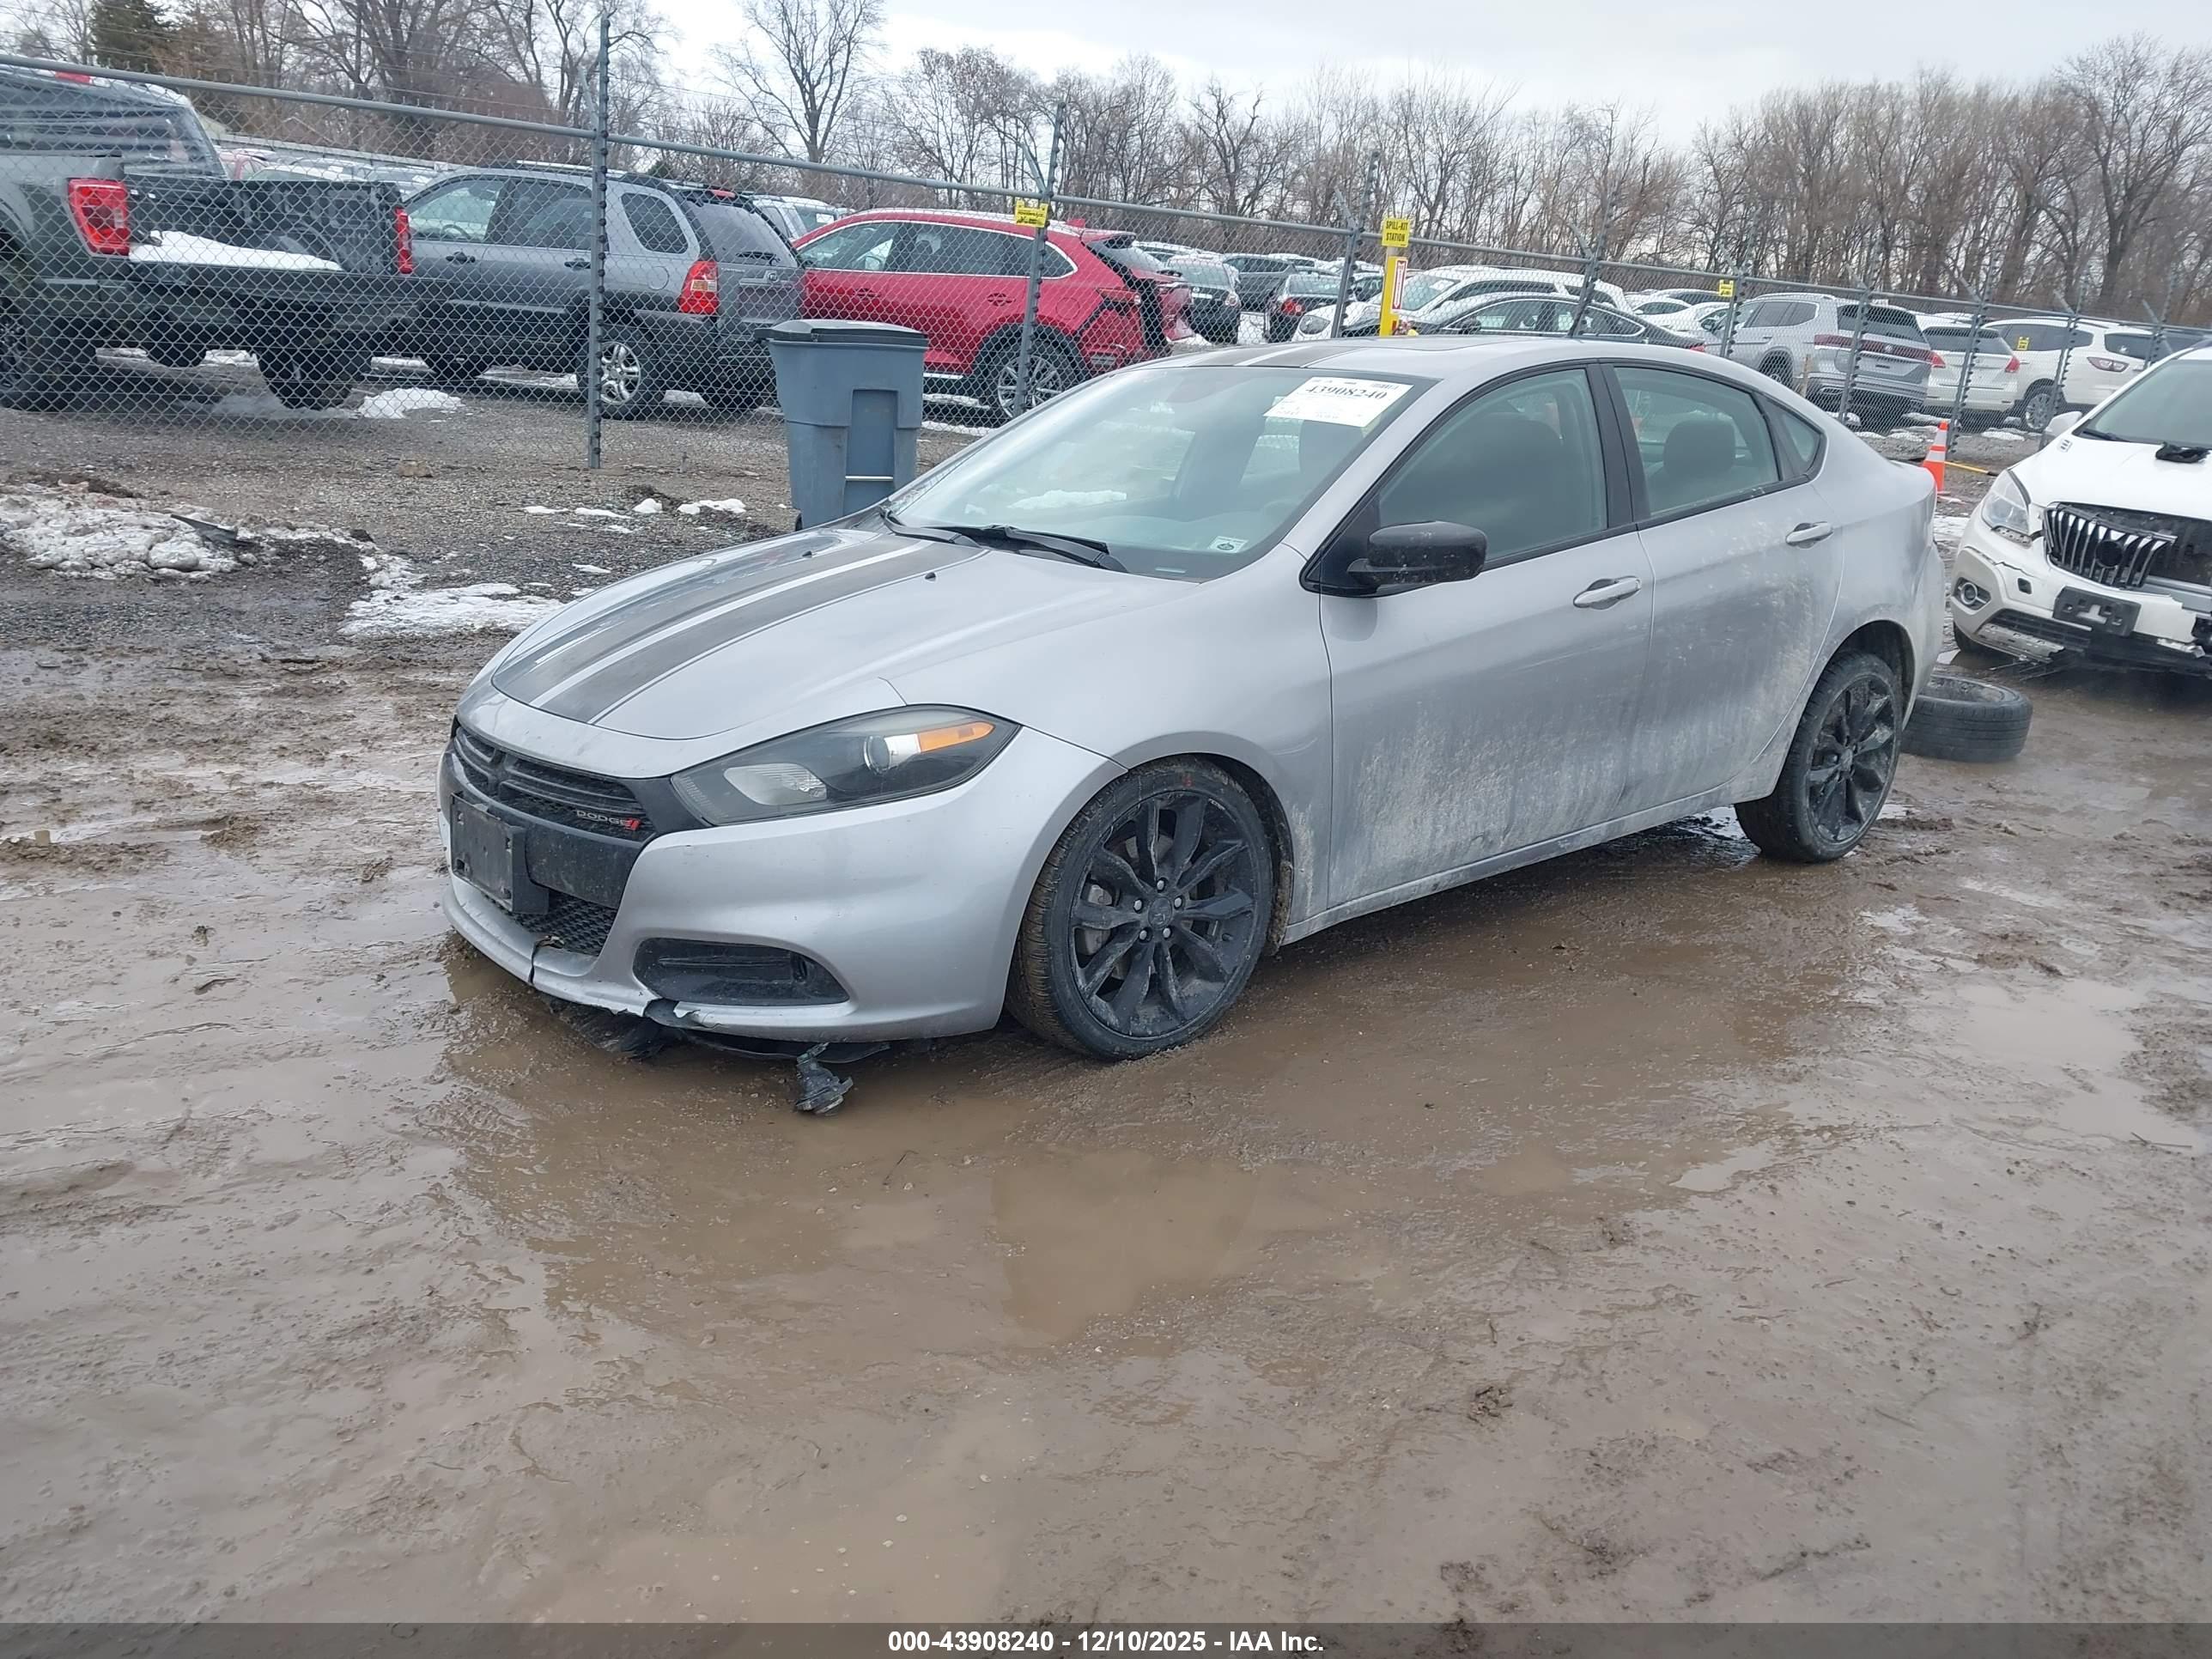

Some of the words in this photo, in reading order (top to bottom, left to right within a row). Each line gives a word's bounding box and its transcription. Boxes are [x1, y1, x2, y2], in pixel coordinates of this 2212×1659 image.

[1386, 220, 1408, 230] SPILL-KIT
[1386, 233, 1406, 241] STATION
[1306, 385, 1388, 400] 43908240
[575, 810, 632, 827] DODGE
